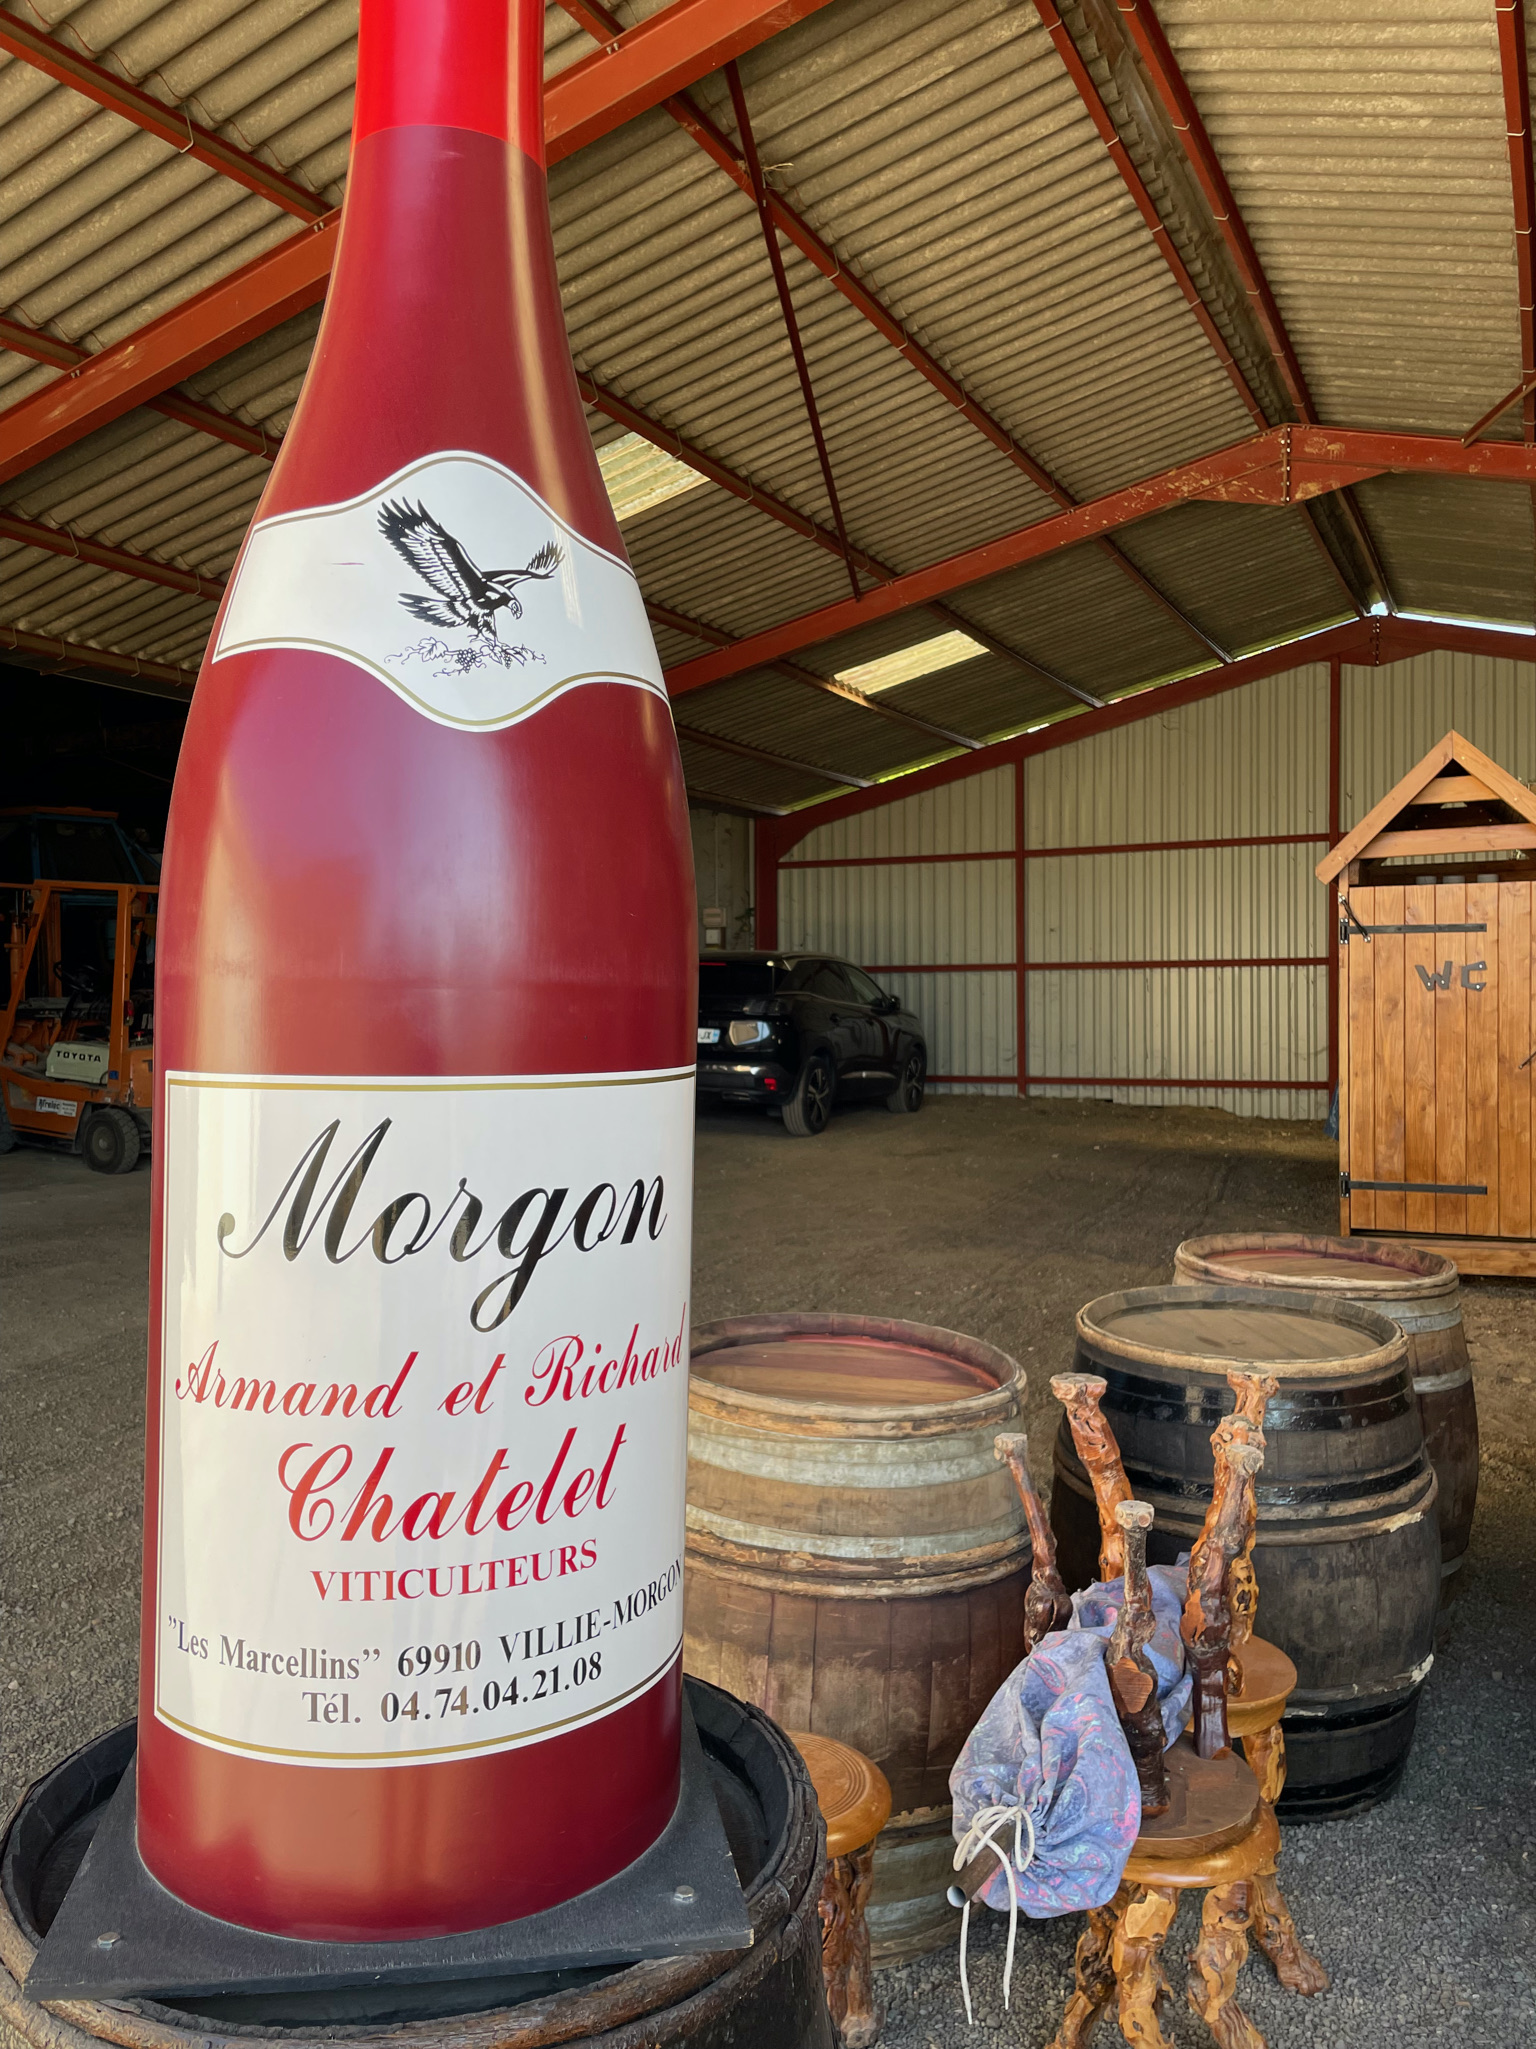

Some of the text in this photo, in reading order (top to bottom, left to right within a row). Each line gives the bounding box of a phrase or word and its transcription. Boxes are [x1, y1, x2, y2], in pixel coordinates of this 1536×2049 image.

[1414, 961, 1487, 992] WC
[56, 1050, 101, 1062] TOYOTA
[217, 1117, 668, 1333] Morgon
[175, 1301, 687, 1419] Armand et Richard
[278, 1423, 627, 1543] Chatelet
[311, 1538, 599, 1602] VITICULTEURS
[397, 1640, 481, 1677] 69910
[499, 1554, 682, 1663] VILLIE-MORGON
[302, 1652, 602, 1724] Tél. 04.74.04.21.08
